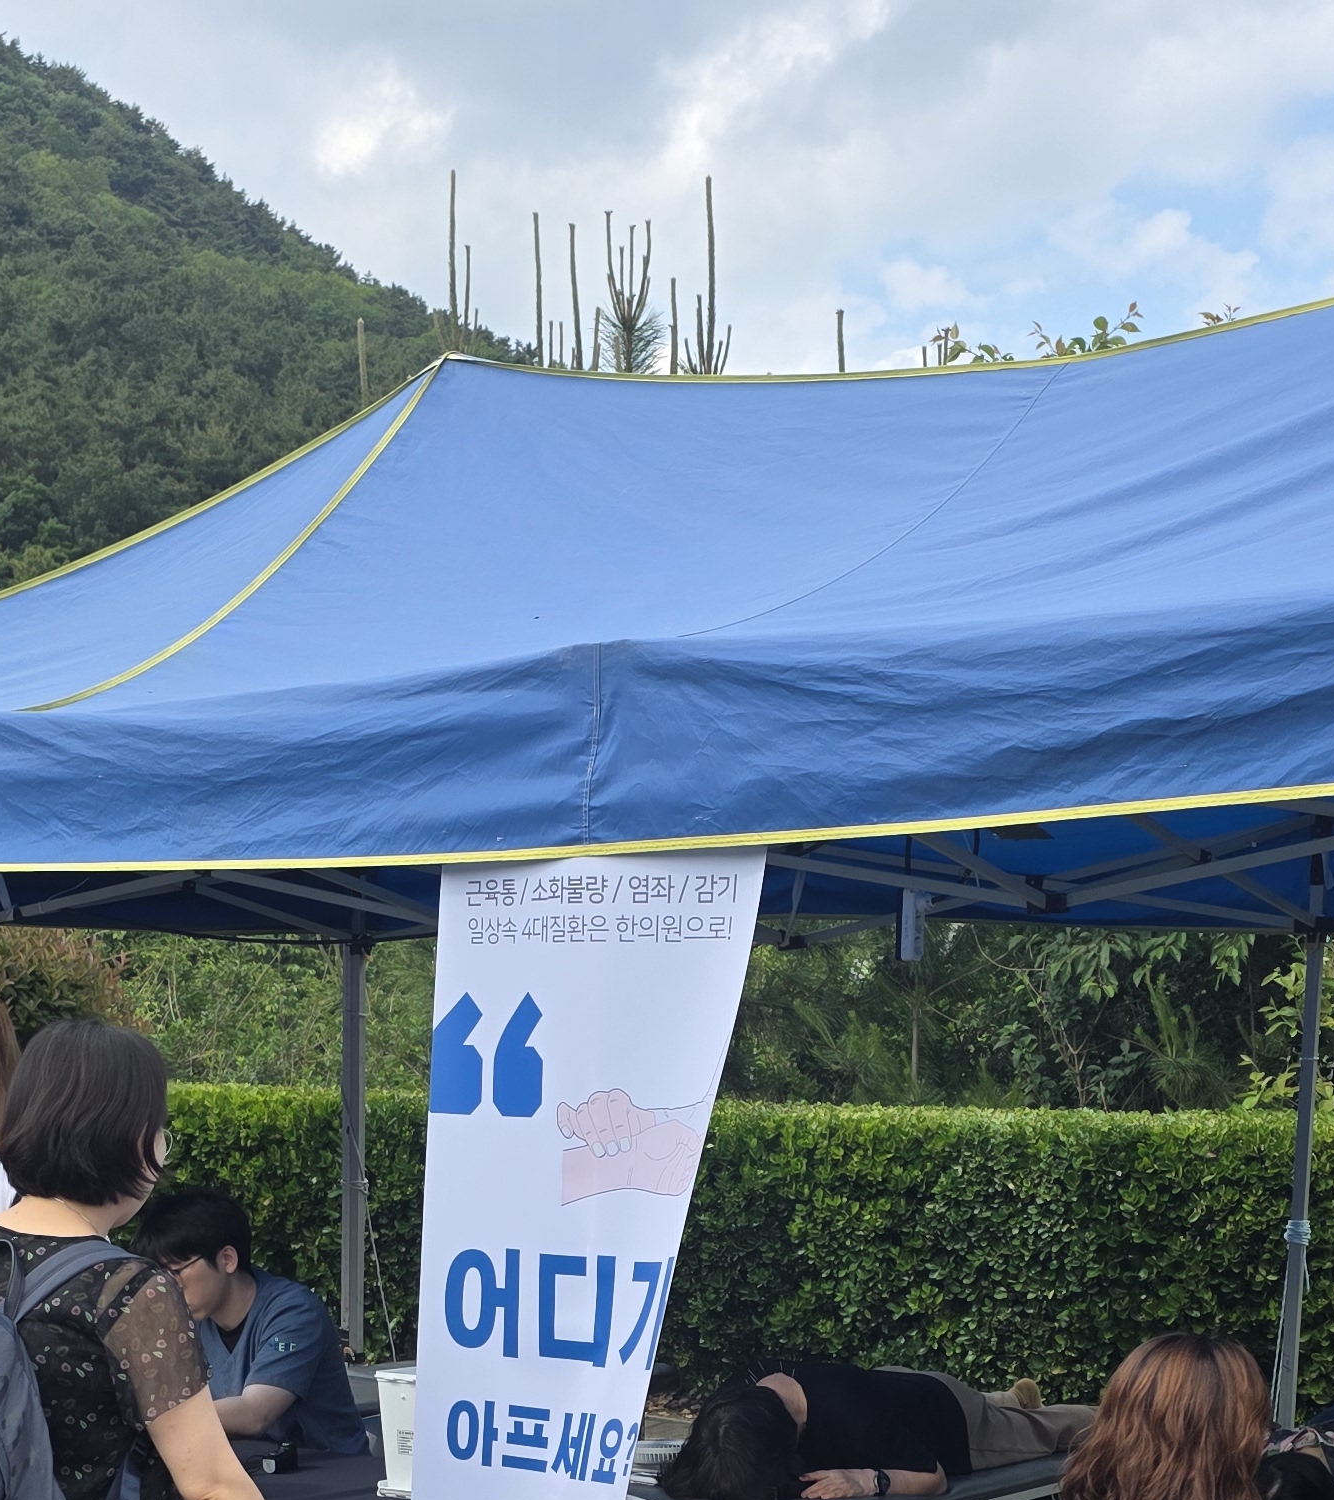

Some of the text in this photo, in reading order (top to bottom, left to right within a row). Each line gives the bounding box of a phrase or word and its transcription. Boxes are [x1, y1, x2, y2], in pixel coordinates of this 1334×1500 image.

[466, 878, 517, 906] 근육통
[531, 875, 608, 905] 소화불량
[628, 874, 675, 904] 염좌
[694, 873, 738, 904] 감기
[468, 914, 733, 945] 일상속 4대질환은 한의원으로!
[447, 1400, 639, 1485] 아프세요?
